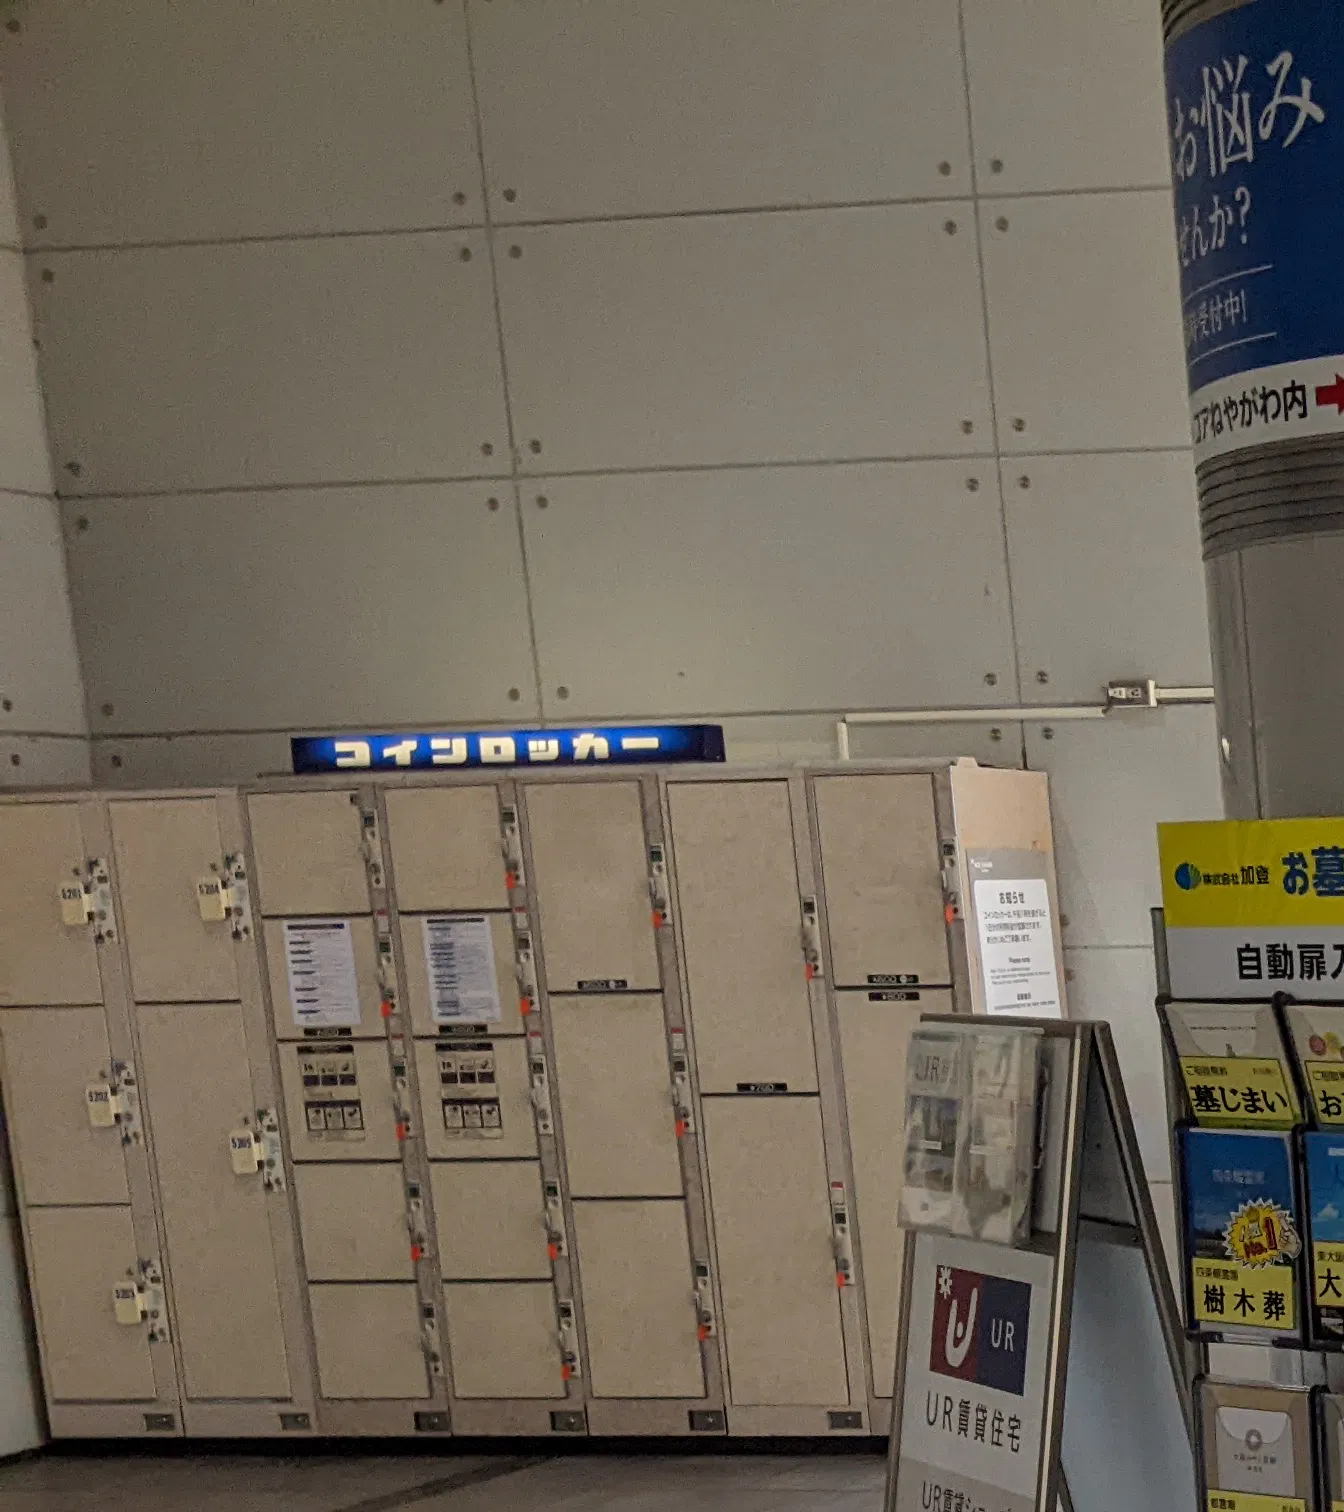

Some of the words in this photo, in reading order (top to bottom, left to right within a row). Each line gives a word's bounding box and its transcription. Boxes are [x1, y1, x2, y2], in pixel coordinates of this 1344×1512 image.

[1174, 50, 1325, 181] お悩み
[334, 733, 660, 768] コインロッカー
[1189, 1085, 1289, 1114] 墓じまい
[1203, 1284, 1286, 1322] 樹木葬
[990, 1318, 1015, 1353] UR
[926, 1390, 1022, 1454] UR賃貸住宅
